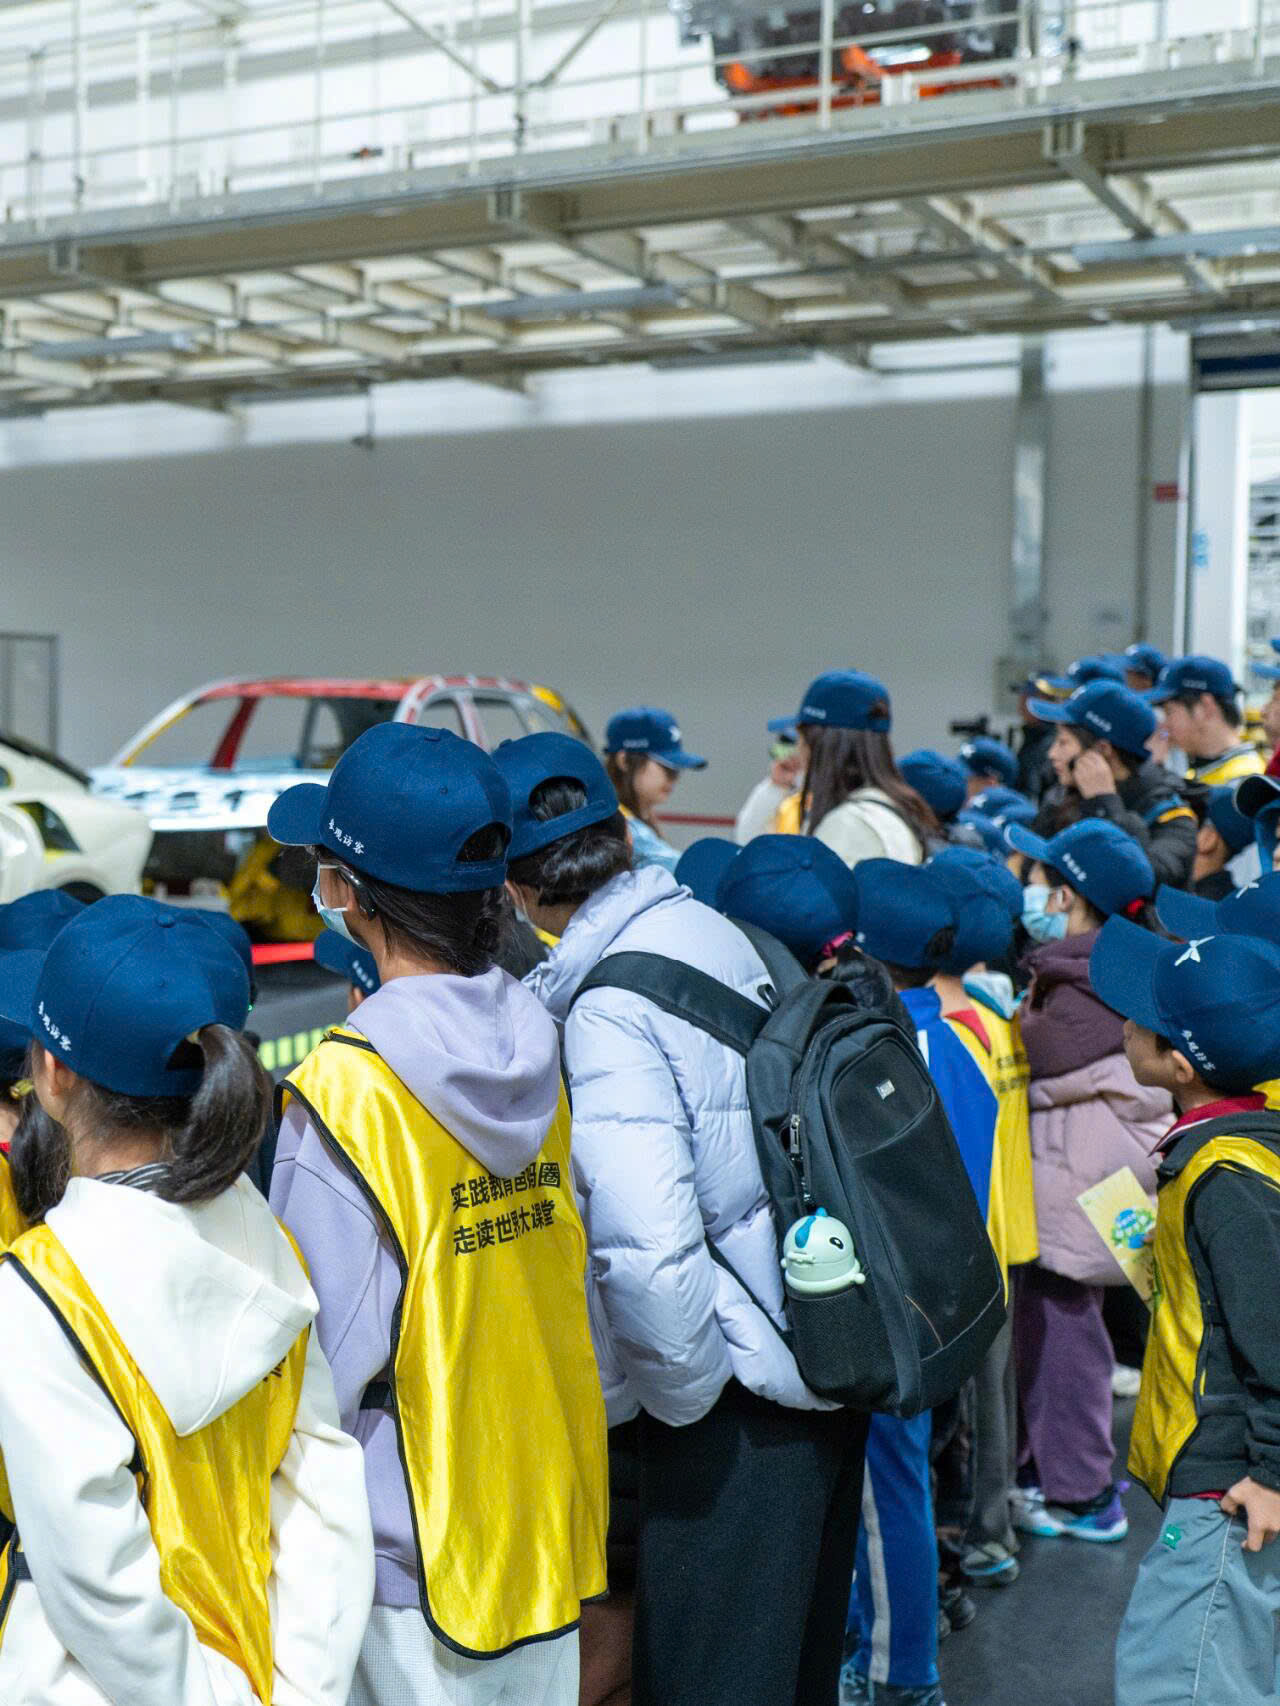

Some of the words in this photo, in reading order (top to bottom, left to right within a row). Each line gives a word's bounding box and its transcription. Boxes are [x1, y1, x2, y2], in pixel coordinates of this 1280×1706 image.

[453, 1200, 556, 1256] 走读世界大课堂
